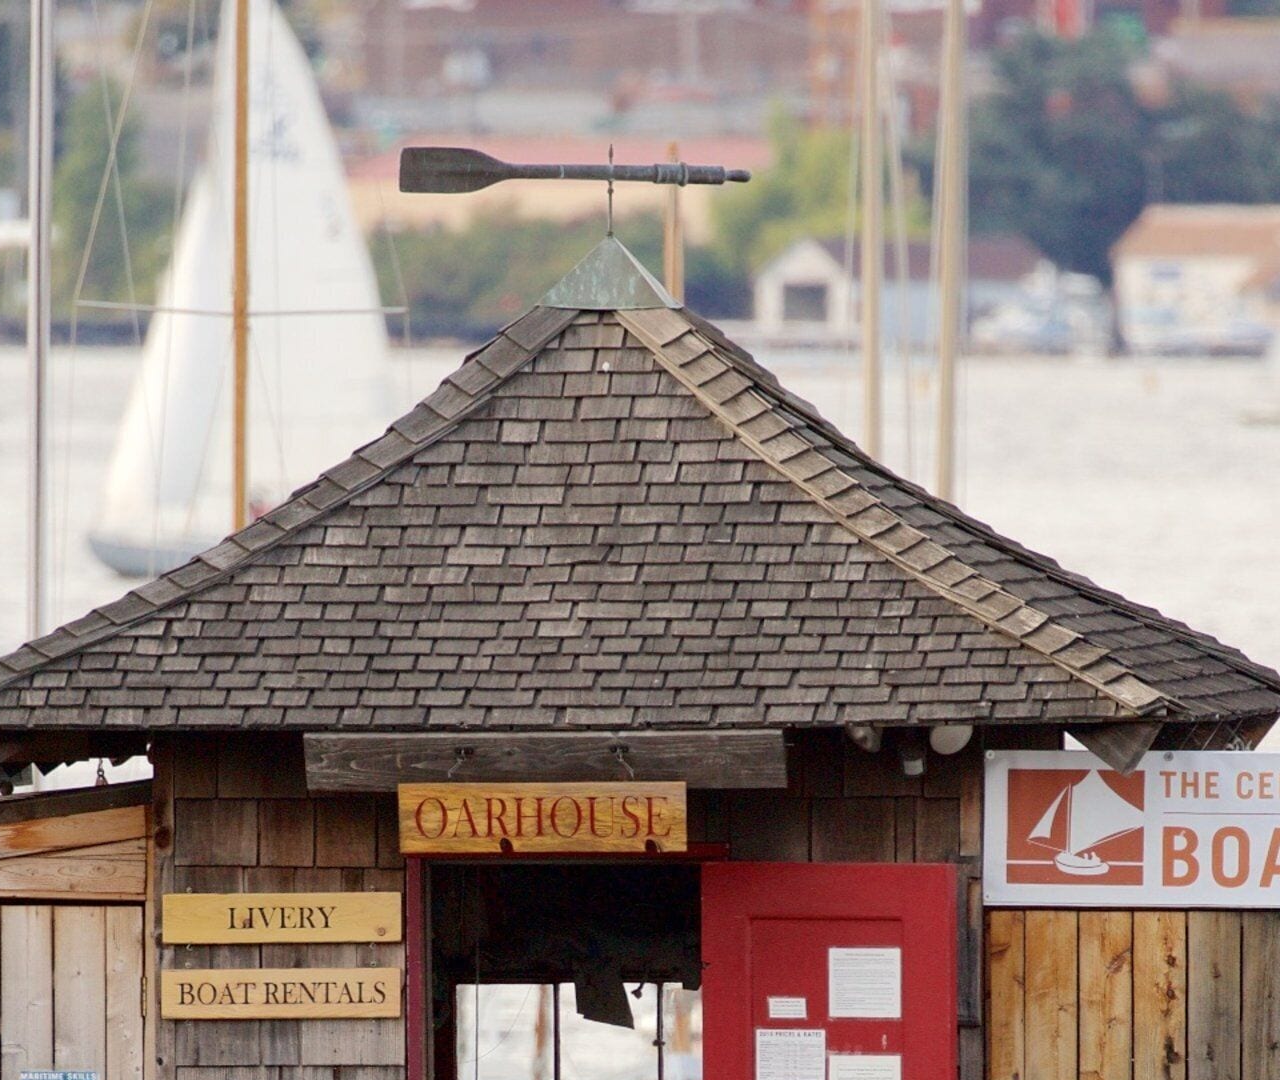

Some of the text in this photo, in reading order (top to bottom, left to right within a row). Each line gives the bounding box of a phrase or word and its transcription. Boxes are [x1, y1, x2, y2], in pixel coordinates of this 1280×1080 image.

[1162, 770, 1220, 800] THE
[413, 794, 673, 840] OARHOUSE
[226, 905, 336, 930] LIVERY
[177, 981, 386, 1005] BOAT RENTALS
[20, 1072, 96, 1080] MARITIME SKILLS
